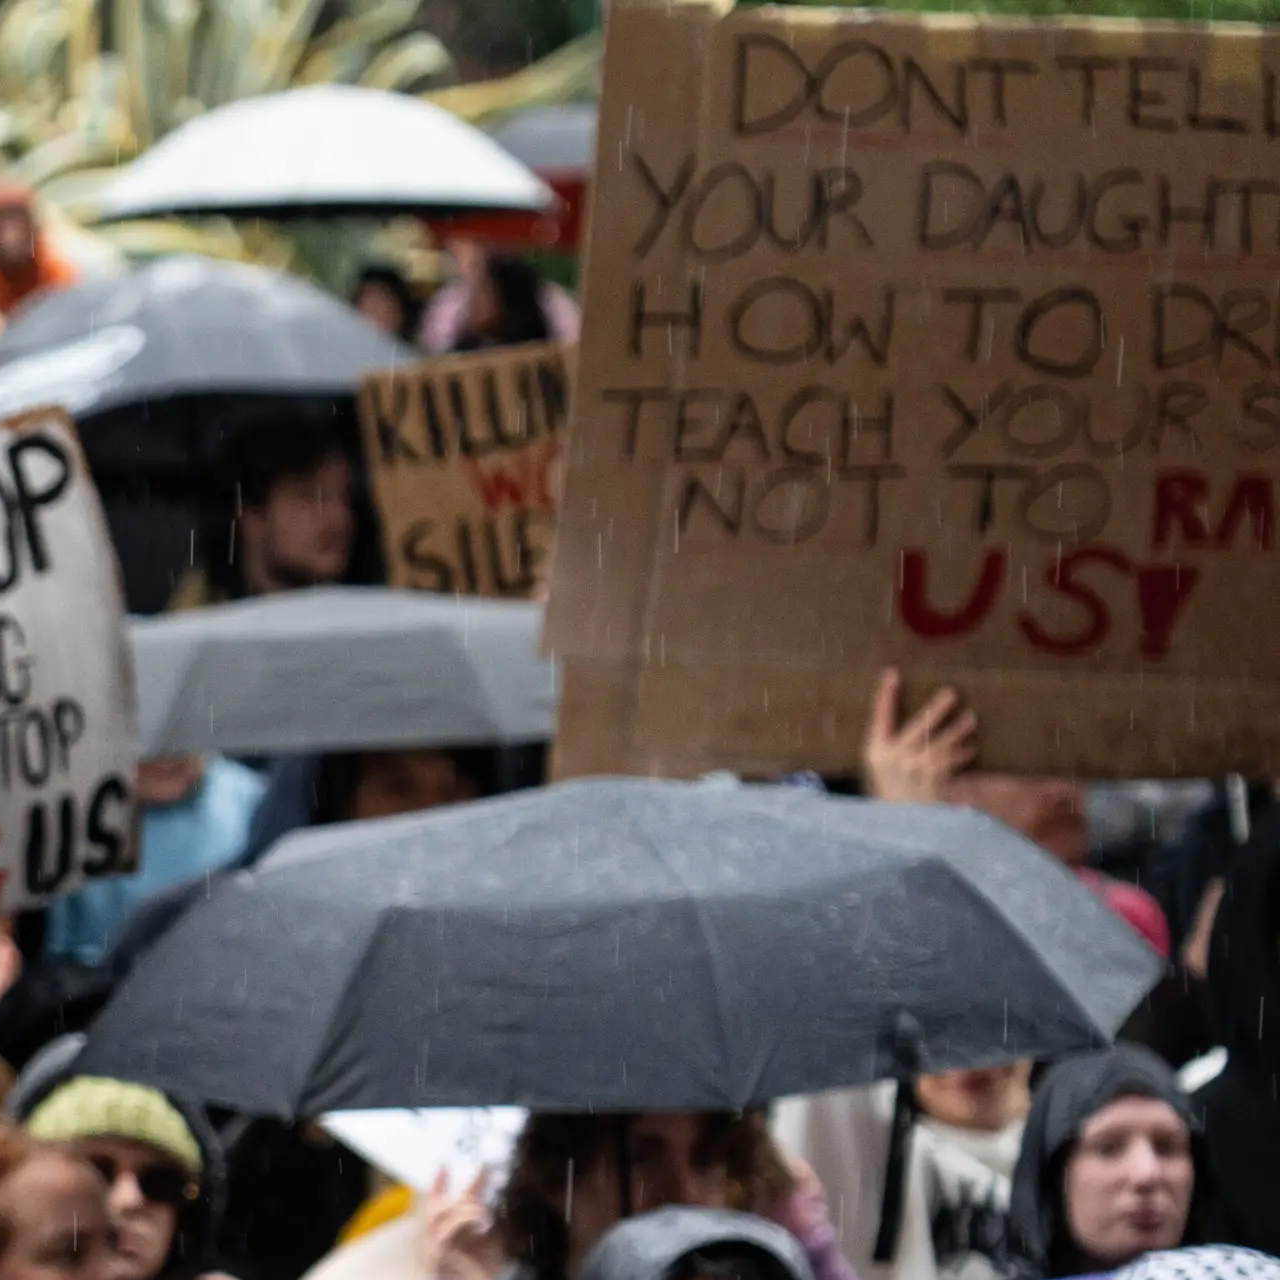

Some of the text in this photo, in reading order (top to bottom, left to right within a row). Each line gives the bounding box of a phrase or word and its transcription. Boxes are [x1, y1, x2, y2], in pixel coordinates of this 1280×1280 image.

[731, 32, 1036, 137] DONT
[631, 153, 1280, 267] YOUR DAUGHT
[628, 277, 898, 368] HOW
[942, 285, 1108, 379] TO
[366, 359, 570, 466] KILLIN
[601, 384, 896, 468] TEACH
[941, 378, 1210, 457] YOUR
[398, 510, 546, 596] SILE
[679, 462, 908, 547] NOT
[945, 461, 1113, 545] TO
